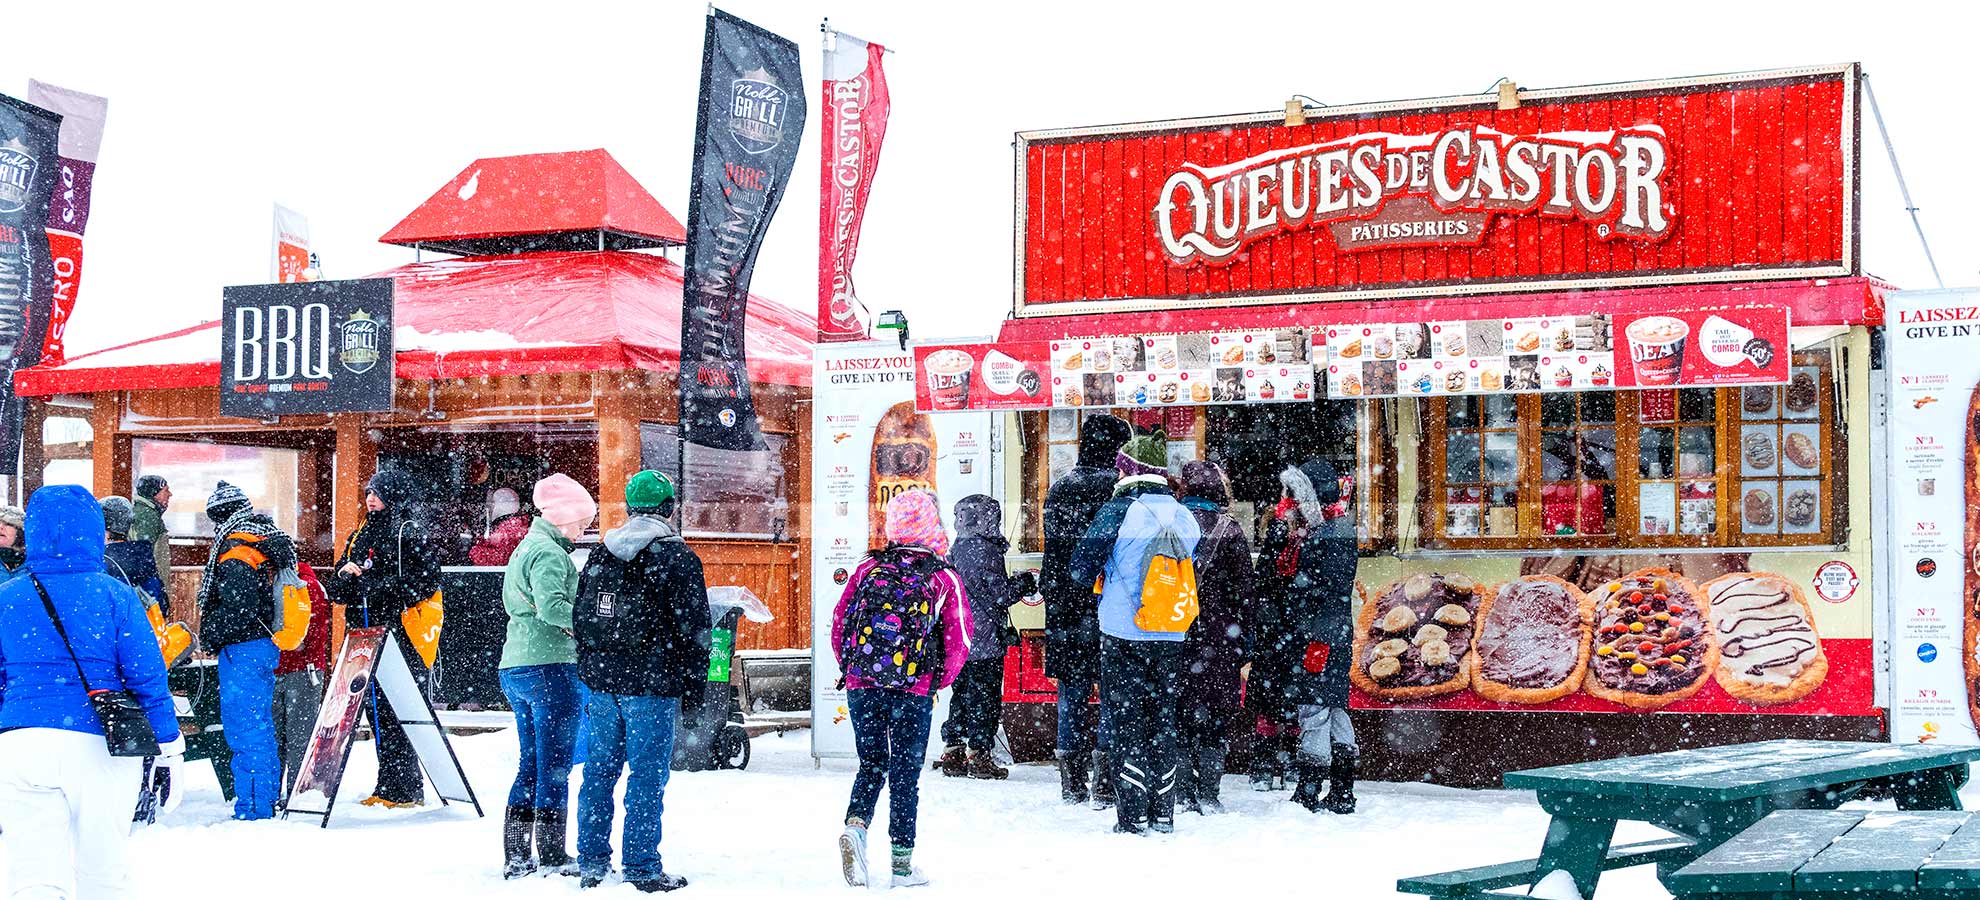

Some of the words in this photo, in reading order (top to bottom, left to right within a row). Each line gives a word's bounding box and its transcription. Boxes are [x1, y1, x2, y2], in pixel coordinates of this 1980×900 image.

[735, 84, 781, 104] Noble
[734, 96, 777, 127] GRILL
[834, 80, 861, 188] CASTOR
[62, 166, 76, 224] SAQ
[1153, 146, 1382, 257] QUEUES
[1385, 151, 1429, 189] DE
[1433, 130, 1667, 232] CASTOR
[1351, 220, 1469, 242] PÂTISSERIES
[234, 303, 333, 381] BBQ
[1906, 326, 1948, 339] GIVE
[1953, 325, 1970, 336] IN
[1711, 345, 1740, 353] COMBO
[826, 357, 912, 371] LAISSEZ-VOU
[831, 373, 859, 384] GIVE
[862, 373, 875, 383] IN
[878, 372, 895, 382] TO
